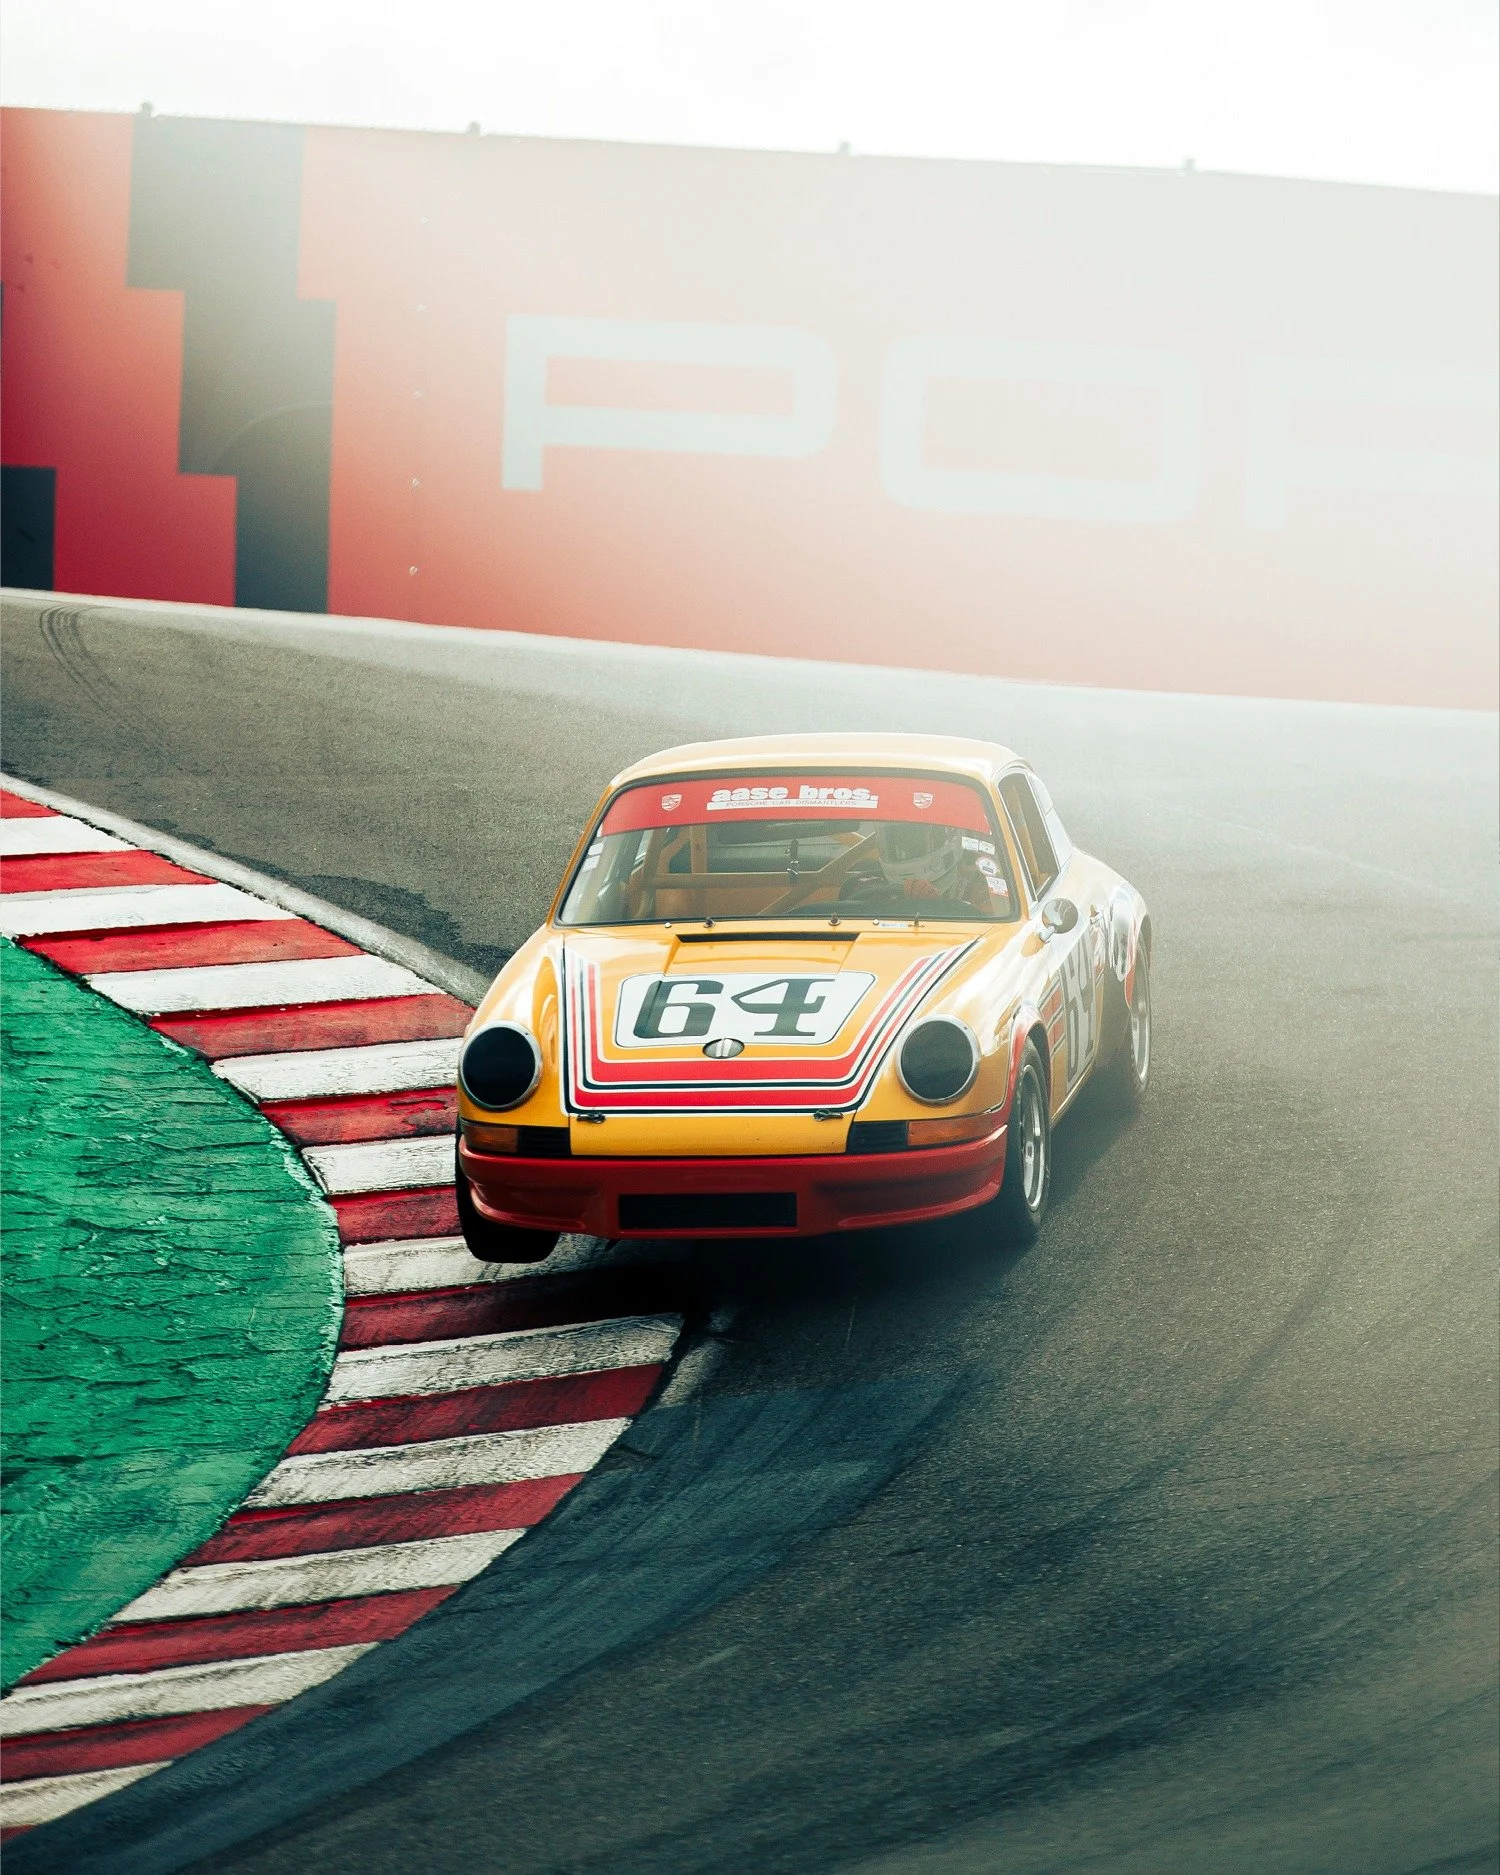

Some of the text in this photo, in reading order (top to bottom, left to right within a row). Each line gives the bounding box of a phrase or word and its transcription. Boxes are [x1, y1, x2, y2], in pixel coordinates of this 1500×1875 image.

[711, 785, 879, 802] aase bros.
[633, 979, 835, 1039] 64
